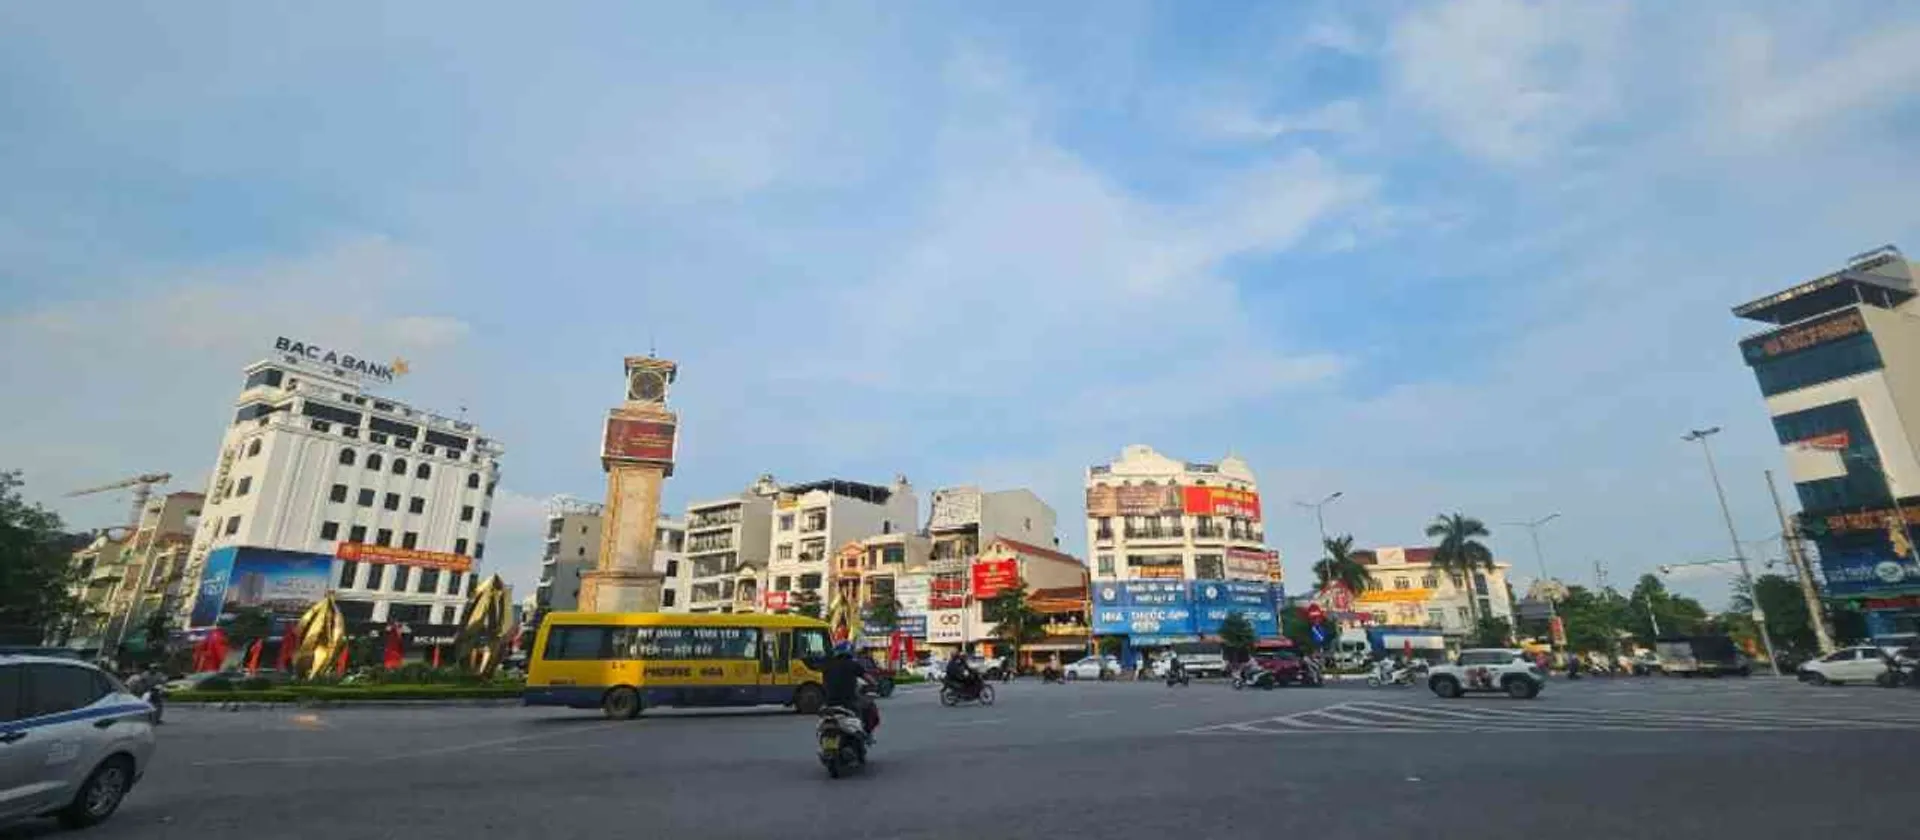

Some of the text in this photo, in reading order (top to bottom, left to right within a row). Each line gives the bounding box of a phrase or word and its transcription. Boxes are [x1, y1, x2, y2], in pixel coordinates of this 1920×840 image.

[275, 336, 393, 382] BAC A BANK
